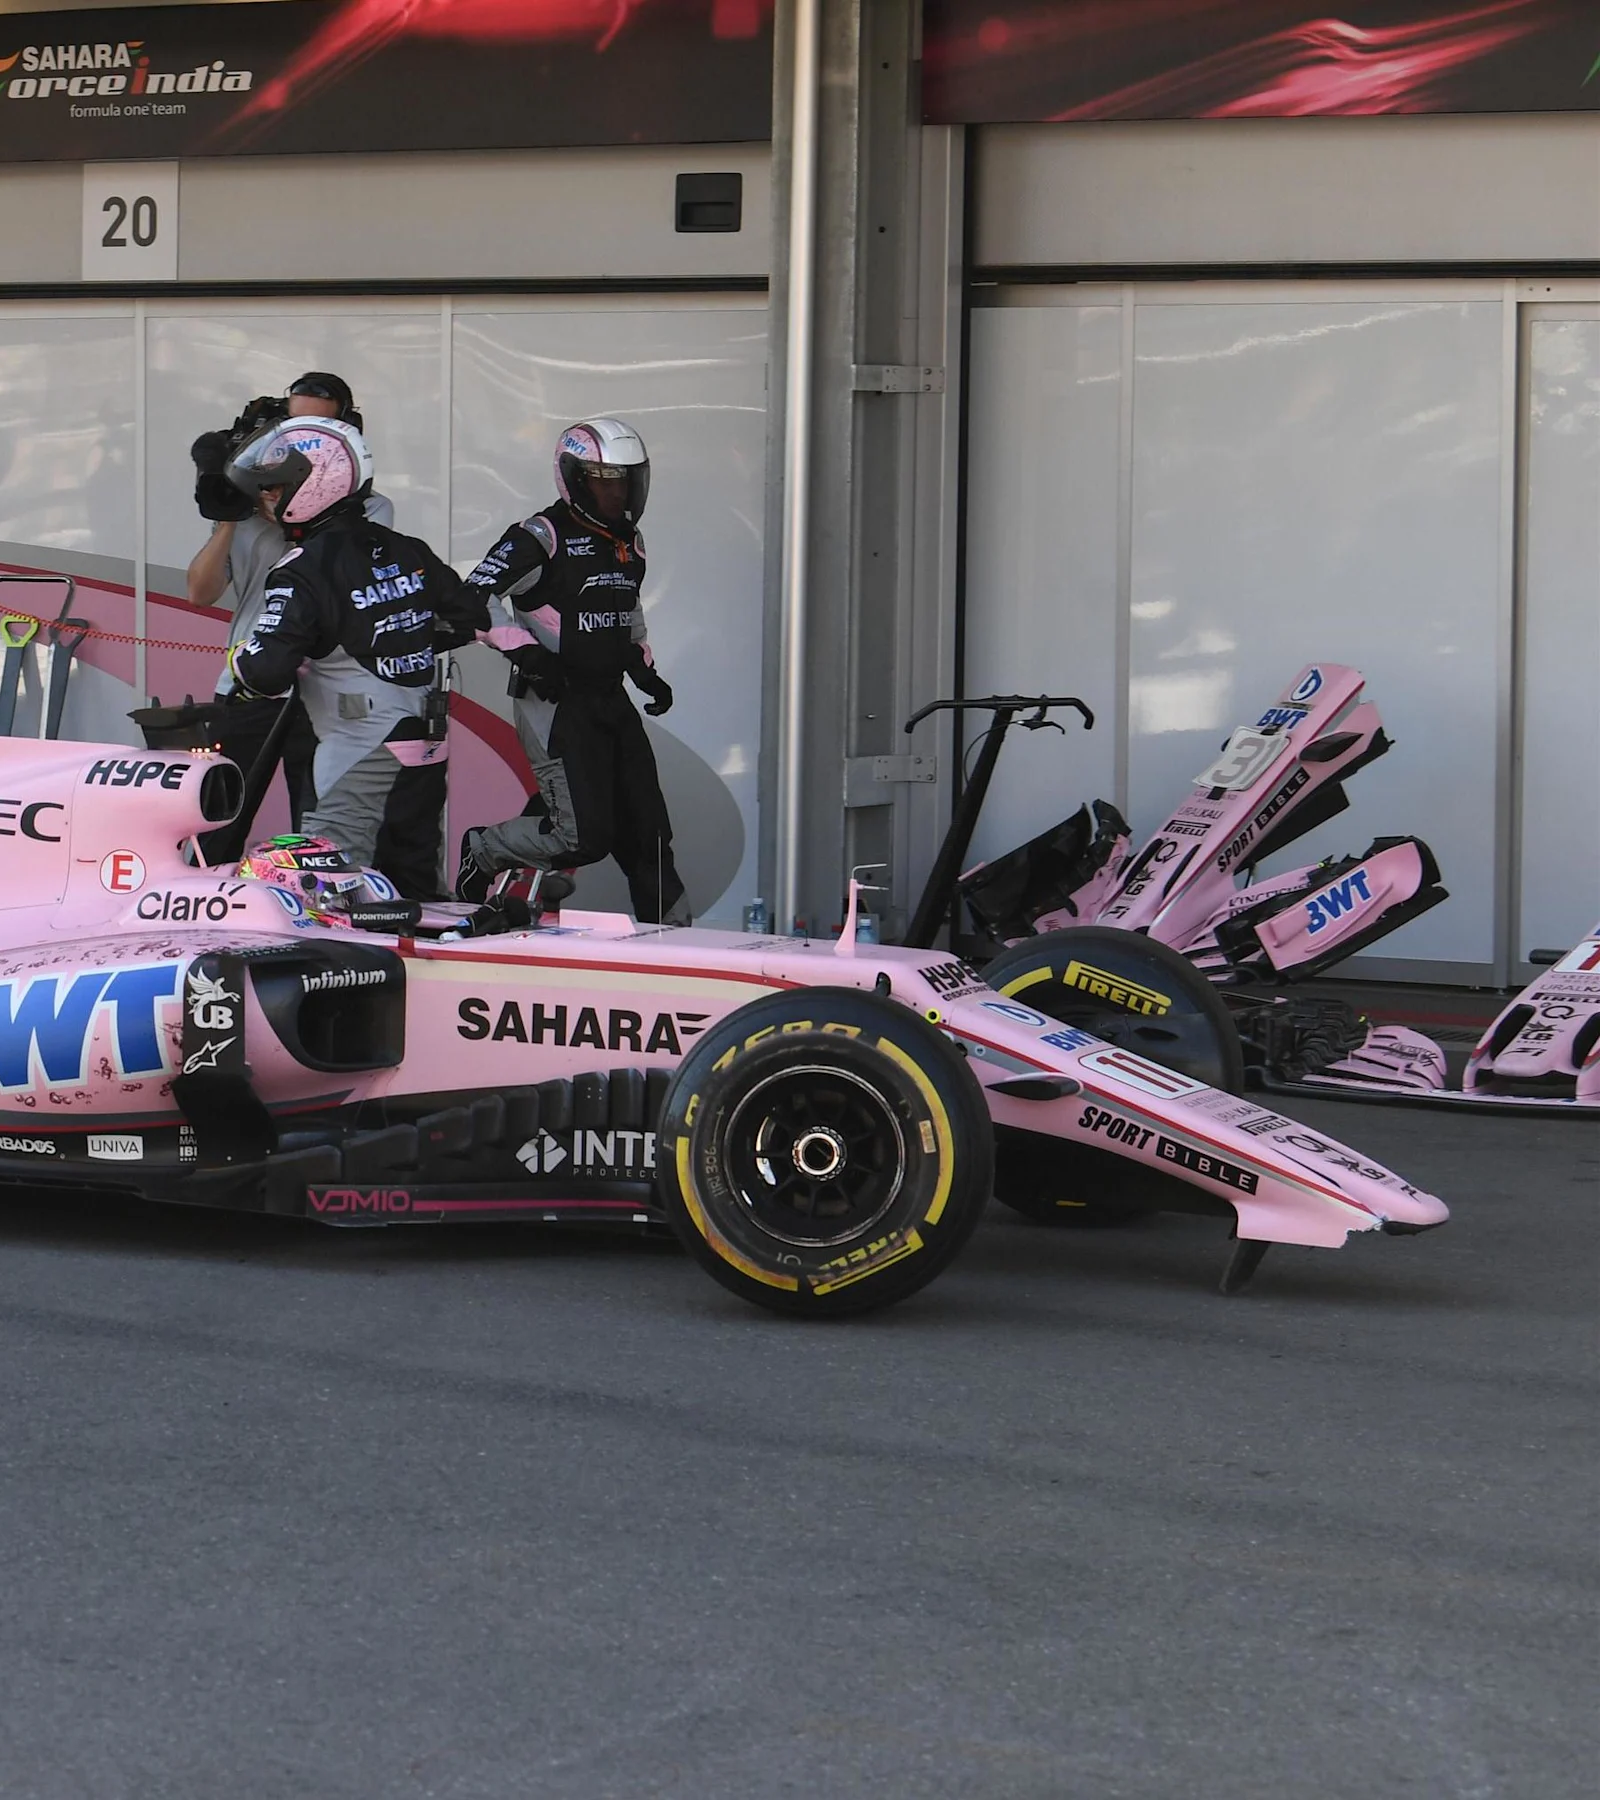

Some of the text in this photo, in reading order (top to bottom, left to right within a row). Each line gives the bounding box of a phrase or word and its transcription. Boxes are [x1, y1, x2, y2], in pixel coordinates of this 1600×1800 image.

[22, 43, 132, 72] SAHARA
[70, 103, 121, 118] formula
[152, 103, 187, 116] team
[101, 195, 158, 248] 20
[565, 437, 587, 456] BWT
[566, 545, 596, 556] NEC
[350, 572, 425, 610] SAHARA
[1256, 708, 1309, 730] BWT
[84, 760, 192, 790] HYPE
[1211, 736, 1280, 786] 31
[1163, 819, 1212, 837] PIRELLI
[1216, 823, 1256, 874] SPORT
[1257, 772, 1308, 826] BIBLE
[111, 854, 134, 891] E
[301, 856, 339, 867] NEC
[137, 886, 232, 921] Claro
[352, 911, 411, 921] #JOINTHEPACT
[1305, 870, 1373, 935] BWT
[301, 968, 387, 993] infinitum
[917, 960, 984, 994] HYPE
[1063, 960, 1172, 1016] PIRELLI
[456, 996, 683, 1057] SAHARA
[1096, 1051, 1194, 1093] 11
[1236, 1115, 1292, 1136] PIRELLI
[90, 1139, 140, 1156] UNIVA
[1078, 1105, 1253, 1190] SPORT BIBLE
